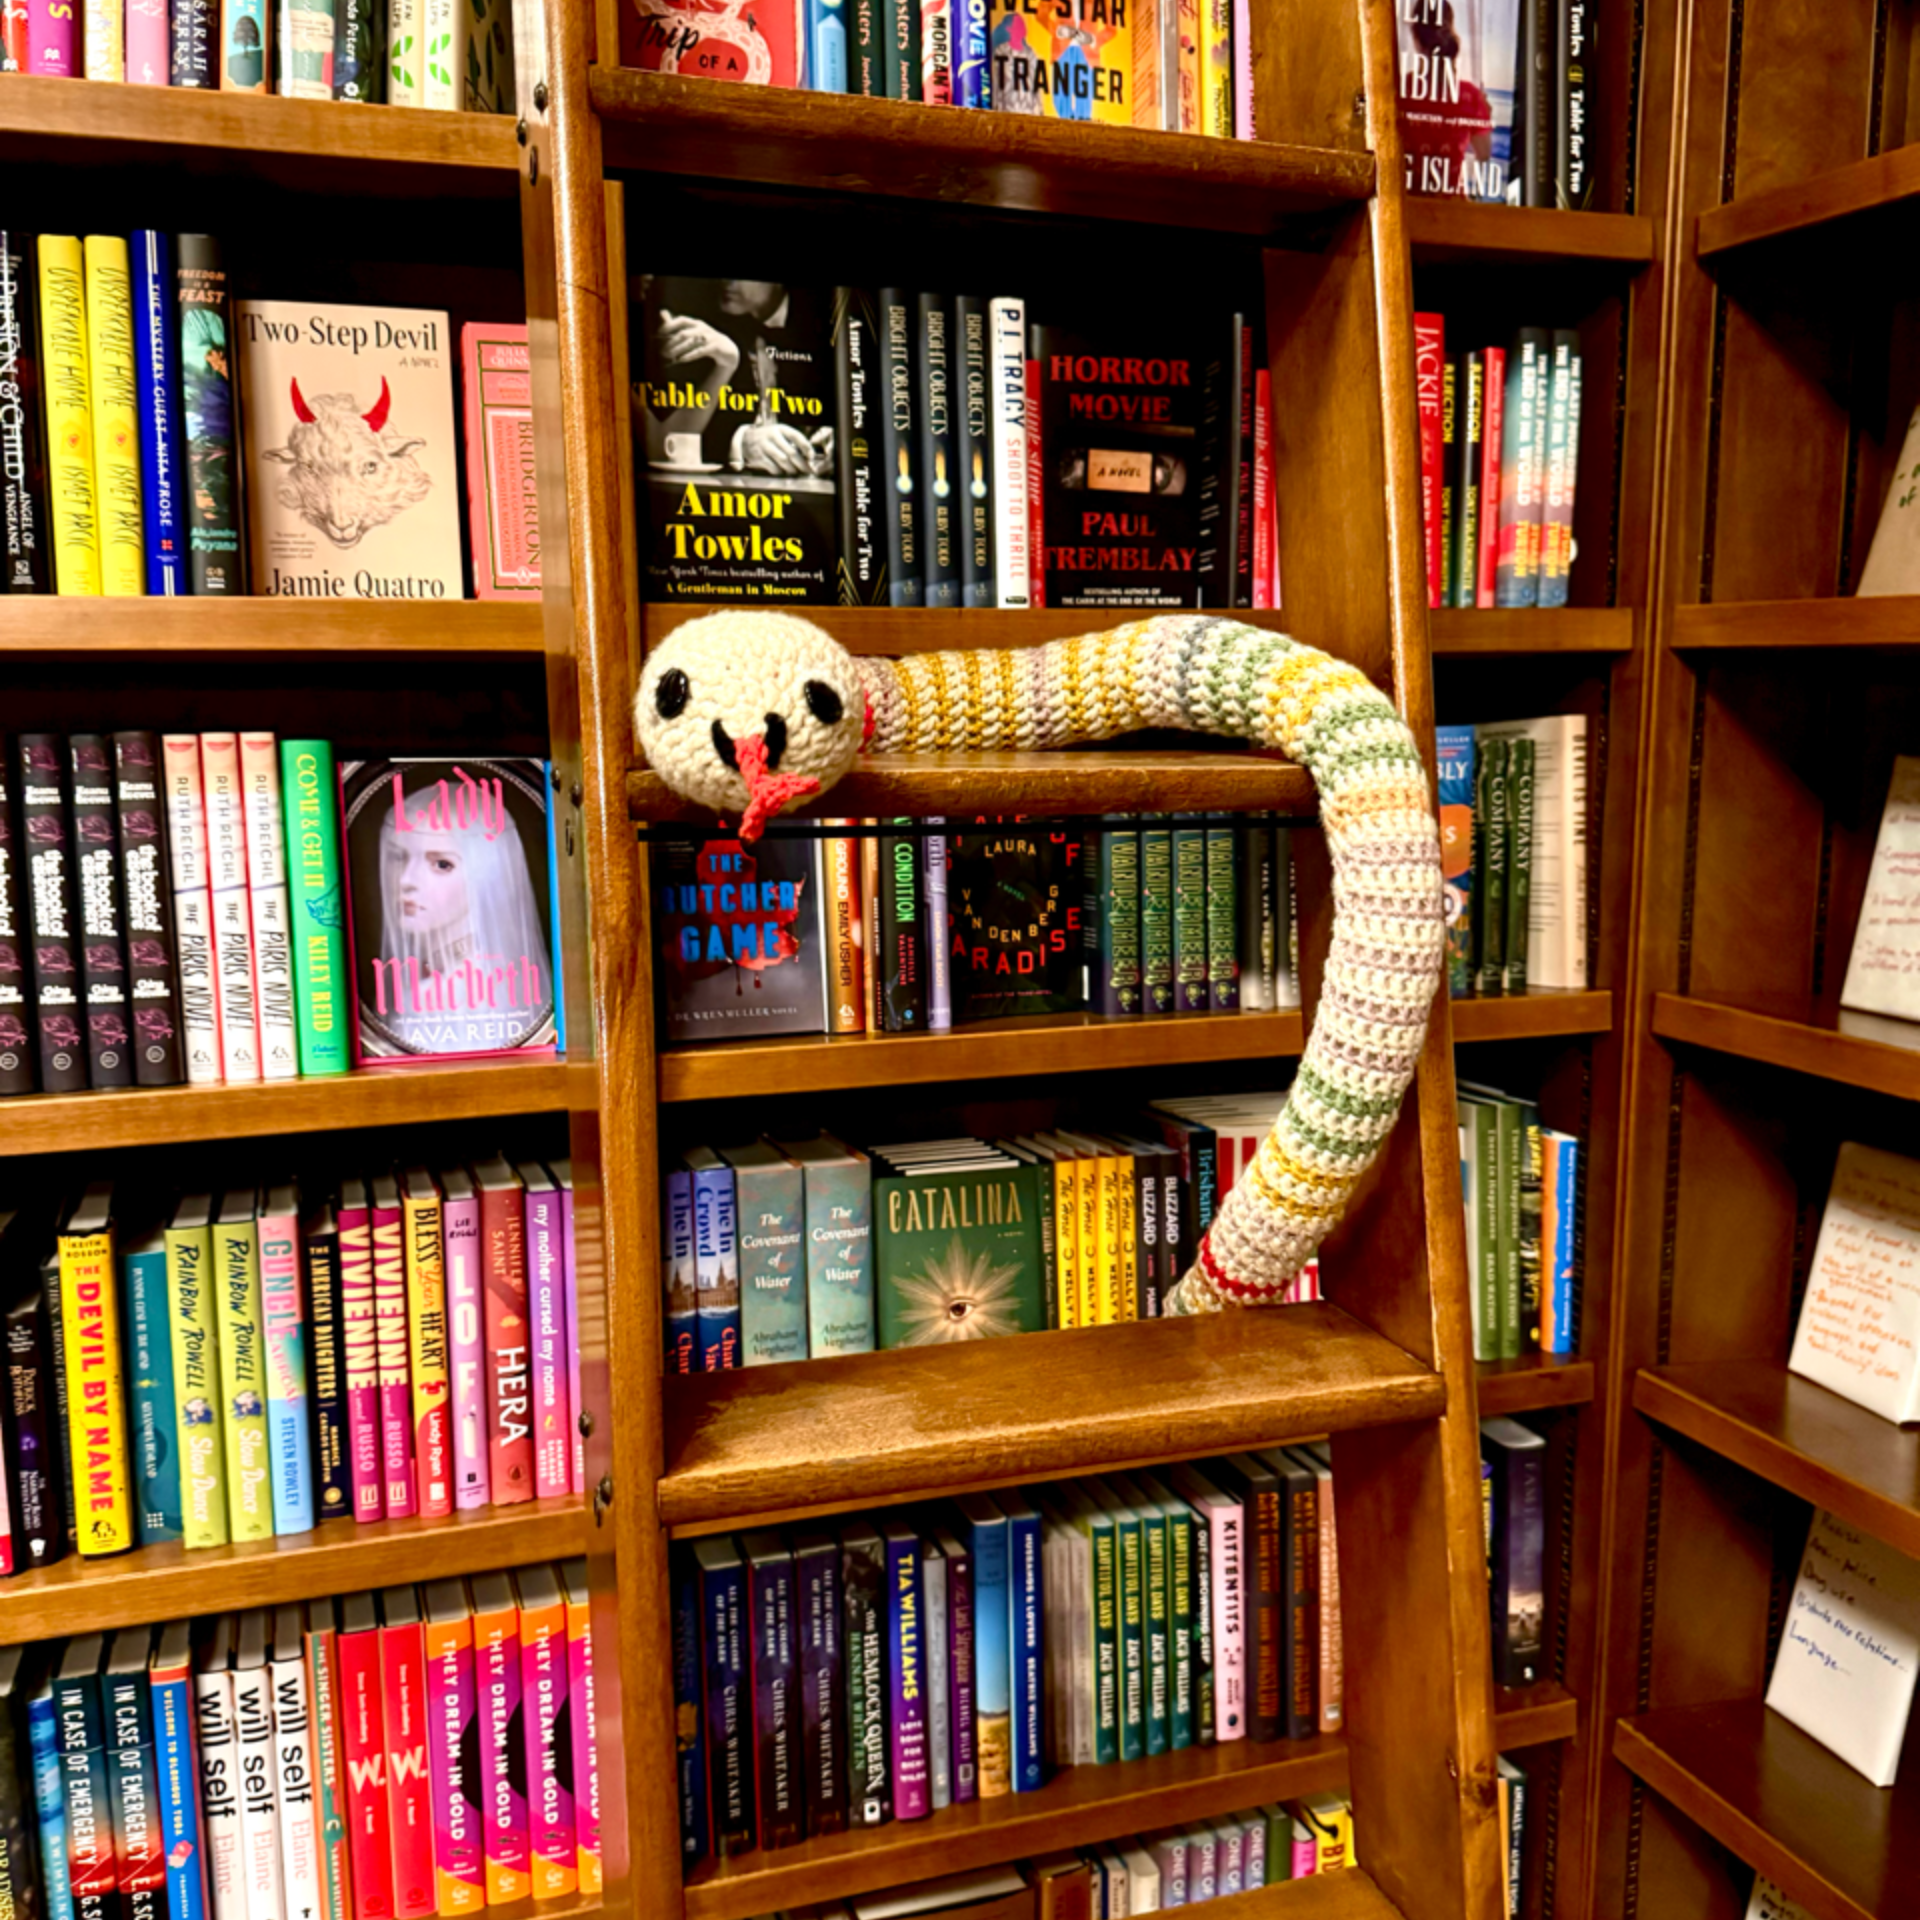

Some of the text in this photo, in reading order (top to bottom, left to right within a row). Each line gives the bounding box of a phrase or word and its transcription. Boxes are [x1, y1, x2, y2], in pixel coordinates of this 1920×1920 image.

[346, 23, 359, 63] Peters
[634, 13, 700, 61] Trip
[699, 54, 739, 72] OF A
[932, 15, 949, 86] MORGAN
[1421, 155, 1502, 198] ISLAND
[1570, 160, 1584, 194] Two
[177, 269, 227, 282] FREEDOM
[178, 288, 226, 306] FEAST
[152, 313, 166, 382] MYSTERY
[242, 313, 439, 355] Two-Step Devil
[765, 345, 813, 363] Fictions
[1003, 351, 1026, 428] TRACY
[1050, 354, 1191, 387] HORROR
[1415, 325, 1440, 417] JACKIE
[153, 387, 167, 434] GUEST
[633, 381, 823, 417] Table for Two
[851, 370, 867, 430] Towles
[1068, 393, 1172, 422] MOVIE
[1442, 363, 1455, 443] REJECTION
[159, 480, 173, 527] PROSE
[676, 480, 793, 519] Amor
[855, 466, 871, 514] Table
[1006, 438, 1026, 579] SHOOT TO THRILL
[20, 490, 35, 549] ANGEL OF
[665, 523, 804, 562] Towles
[858, 516, 872, 543] for
[1081, 511, 1156, 537] PAUL
[266, 568, 446, 600] Jamie Quatro
[859, 545, 872, 581] Two
[1045, 546, 1197, 572] TREMBLAY
[676, 582, 744, 595] Gentleman
[746, 583, 759, 595] in
[176, 776, 195, 883] RUTH REICHL
[295, 753, 325, 869] COME & GET
[392, 765, 505, 842] Lady
[1489, 777, 1505, 874] COMPANY
[709, 853, 743, 873] THE
[984, 839, 1037, 859] LAURA
[661, 880, 796, 915] BUTCHER
[894, 842, 915, 923] CONDITION
[180, 903, 214, 1032] THE PARIS NOVEL
[680, 921, 780, 963] GAME
[837, 901, 853, 988] EMILY USHER
[307, 934, 333, 1033] KILEY REID
[371, 955, 542, 1016] Macbeth
[409, 1020, 524, 1045] AVA REID
[697, 1186, 717, 1258] Crowd
[760, 1213, 783, 1227] The
[888, 1181, 1023, 1234] CATALINA
[1141, 1176, 1157, 1246] BLIZZARD
[66, 1248, 107, 1259] ROSSON
[71, 1239, 102, 1249] KEITH
[414, 1207, 440, 1263] BLESS
[491, 1230, 506, 1276] SAINT
[741, 1233, 802, 1249] Covenant
[767, 1251, 783, 1268] of
[262, 1238, 298, 1340] GUNCLE
[310, 1258, 333, 1323] AMERICAN
[339, 1223, 377, 1391] VIVIENNE
[533, 1203, 558, 1407] my mother cursed my name
[754, 1275, 792, 1290] Water
[175, 1243, 206, 1390] RAINBOW ROWELL
[419, 1311, 445, 1372] HEART
[77, 1282, 114, 1513] DEVIL BY NAME
[496, 1346, 529, 1447] HERA
[280, 1417, 299, 1508] STEVEN ROWLEY
[356, 1422, 373, 1473] RUSSO
[428, 1411, 444, 1477] Lindy Ryan
[189, 1435, 217, 1522] Slow Dance
[1223, 1519, 1242, 1635] KITTENTITS
[898, 1554, 919, 1701] TIA WILLIAMS
[1099, 1599, 1113, 1630] DAYS
[850, 1631, 866, 1771] HANNAH WHITTEN
[864, 1632, 882, 1727] HEMLOCK
[1101, 1673, 1115, 1730] WILLIAMS
[163, 1689, 177, 1738] WELCOME
[441, 1639, 466, 1842] THEY DREAM IN GOLD
[167, 1741, 178, 1755] TO
[200, 1690, 237, 1819] will self
[348, 1753, 387, 1795] W.
[723, 1685, 741, 1820] CHRIS WHITAKER
[865, 1726, 885, 1793] QUEEN
[61, 1687, 98, 1866] IN CASE OF EMERGENCY
[215, 1832, 233, 1895] Elaine
[1172, 1845, 1185, 1898] ONE OF
